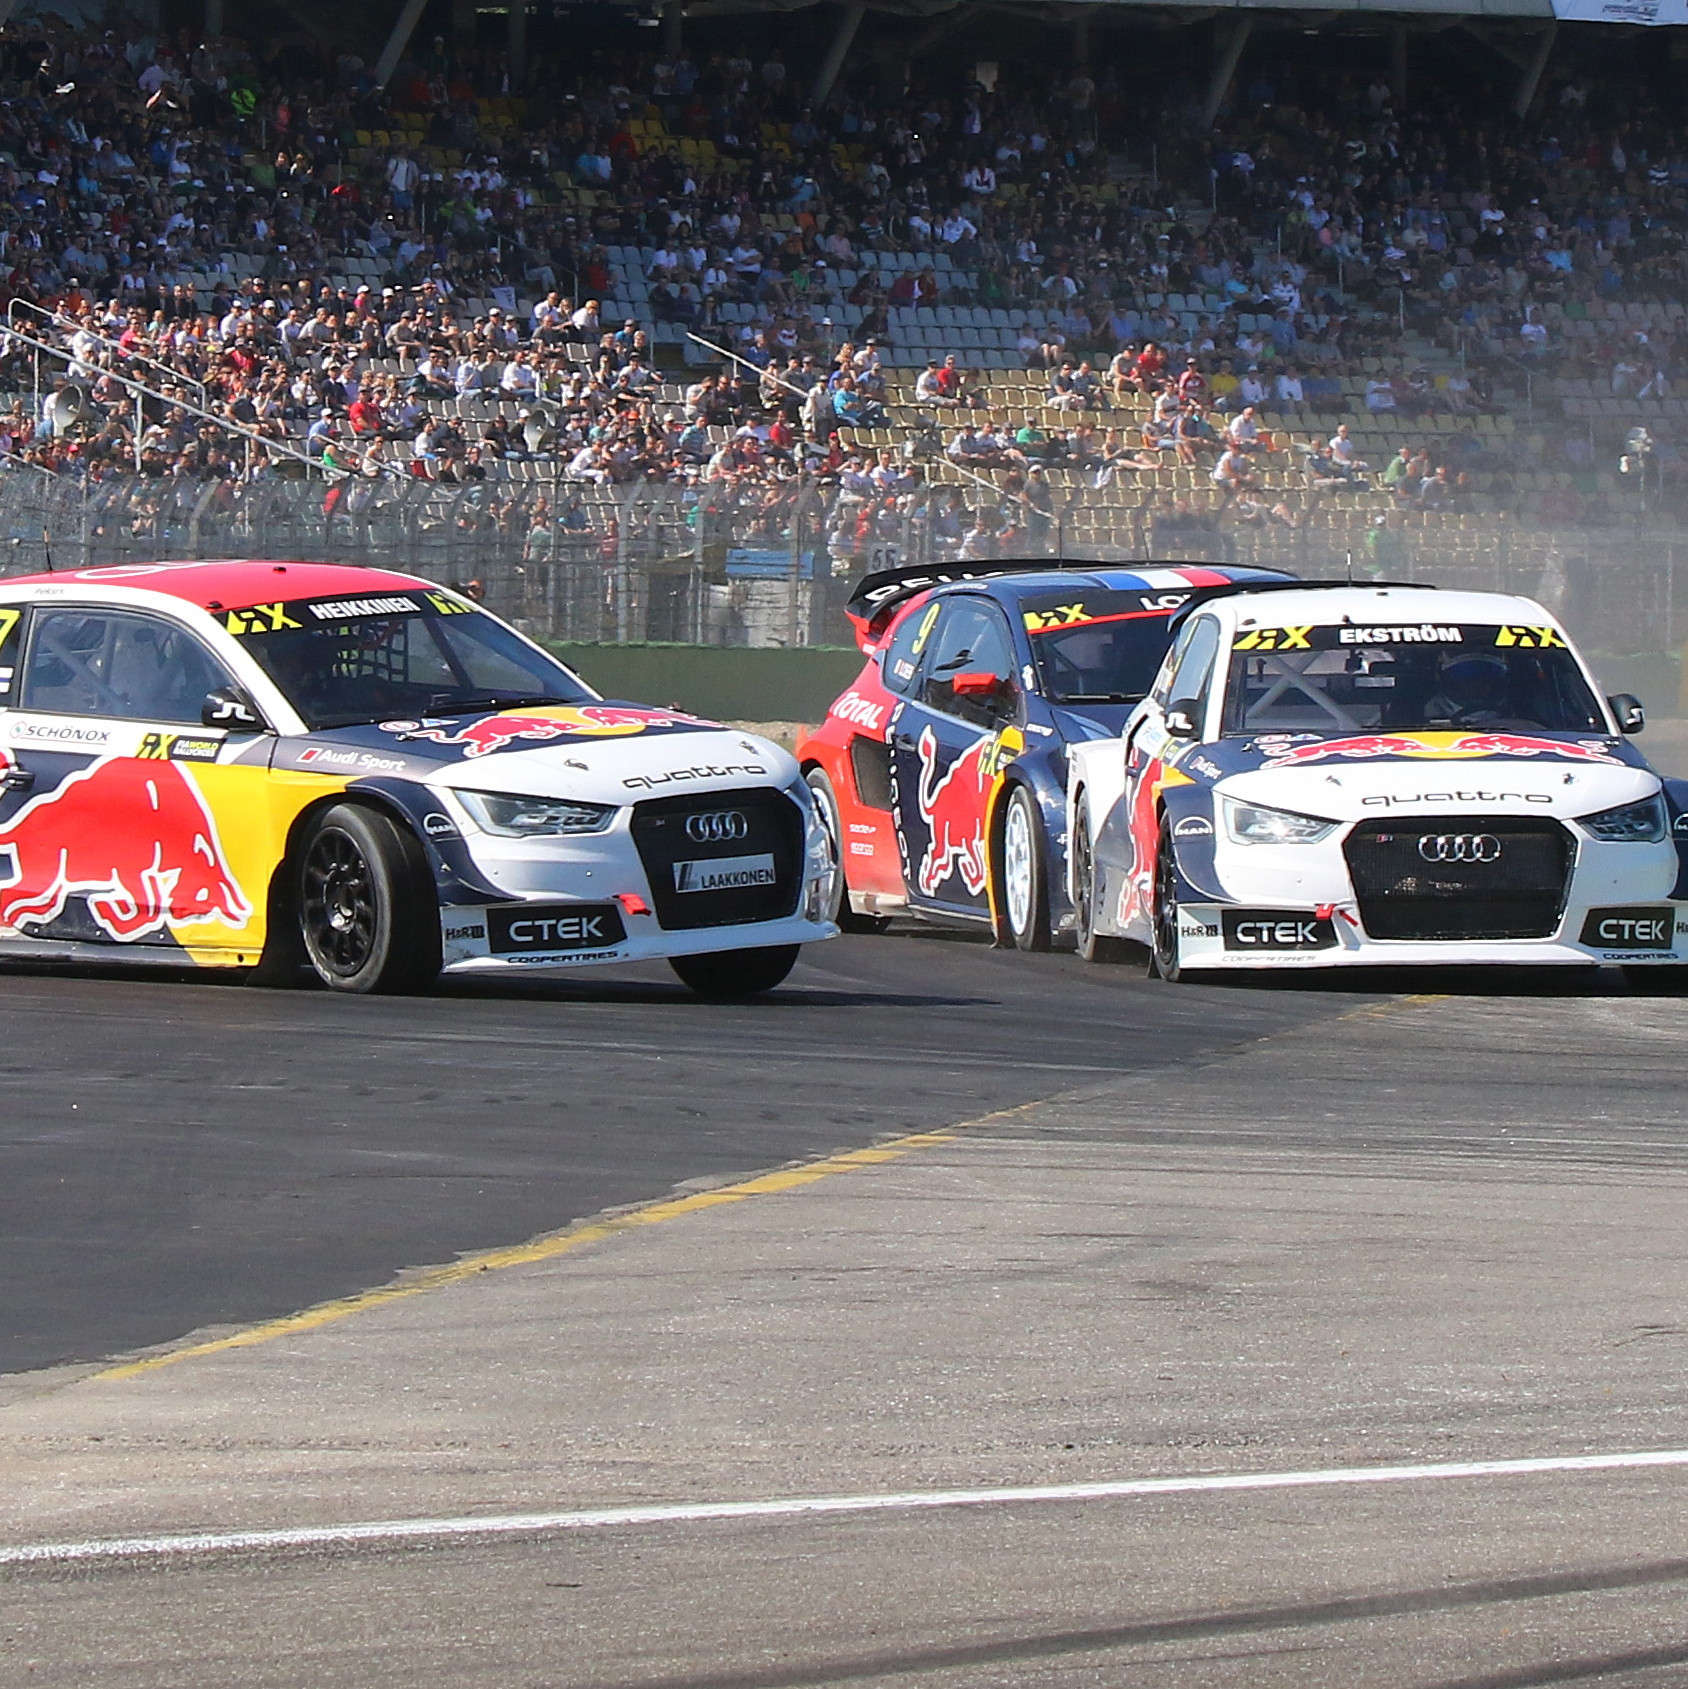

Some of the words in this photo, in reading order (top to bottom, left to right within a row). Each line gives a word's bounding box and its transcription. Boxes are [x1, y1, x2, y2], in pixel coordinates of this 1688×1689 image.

[307, 596, 421, 620] HEIKKINEN
[912, 603, 940, 654] 9
[1339, 624, 1464, 644] EKSTRÖM
[833, 692, 884, 729] TOTAL
[25, 724, 111, 742] SCHÖNOX
[318, 749, 358, 763] Audi
[358, 754, 406, 771] Sport
[621, 765, 768, 789] quattro
[1361, 791, 1553, 807] quattro
[701, 868, 776, 889] LAAKKONEN
[508, 915, 603, 942] CTEK
[1236, 921, 1318, 943] CTEK
[1599, 919, 1664, 940] CTEK
